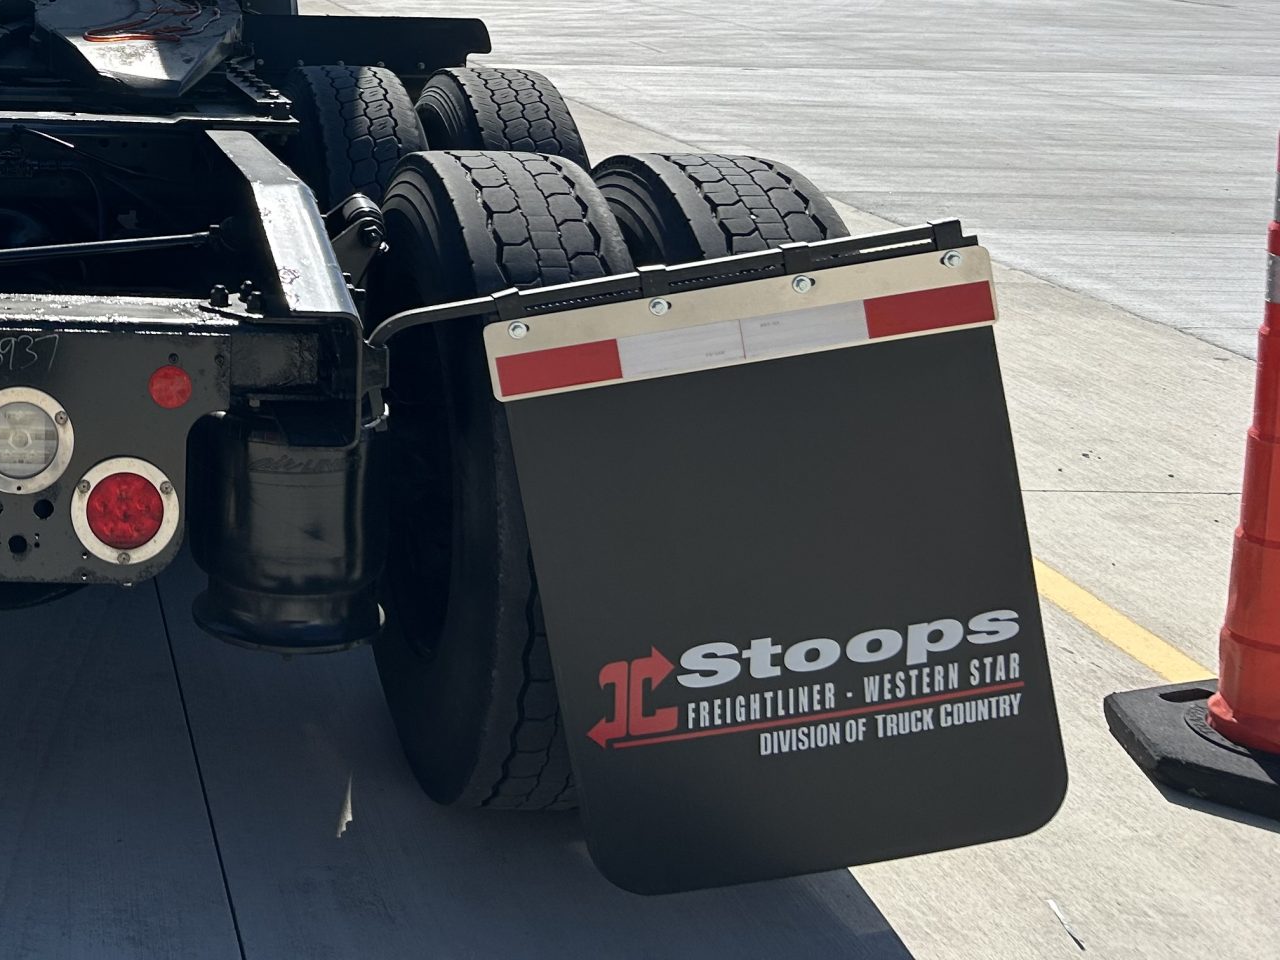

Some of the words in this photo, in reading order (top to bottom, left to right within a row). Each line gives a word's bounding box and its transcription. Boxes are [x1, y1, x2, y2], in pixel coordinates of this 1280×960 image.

[676, 609, 1020, 689] Stoops
[687, 682, 836, 729] FREIGHTLINER
[863, 662, 960, 703] WESTERN
[969, 652, 1020, 686] STAR
[759, 721, 841, 756] DIVISION
[845, 717, 867, 743] OF
[874, 710, 935, 738] TRUCK
[939, 692, 1022, 728] COUNTRY
